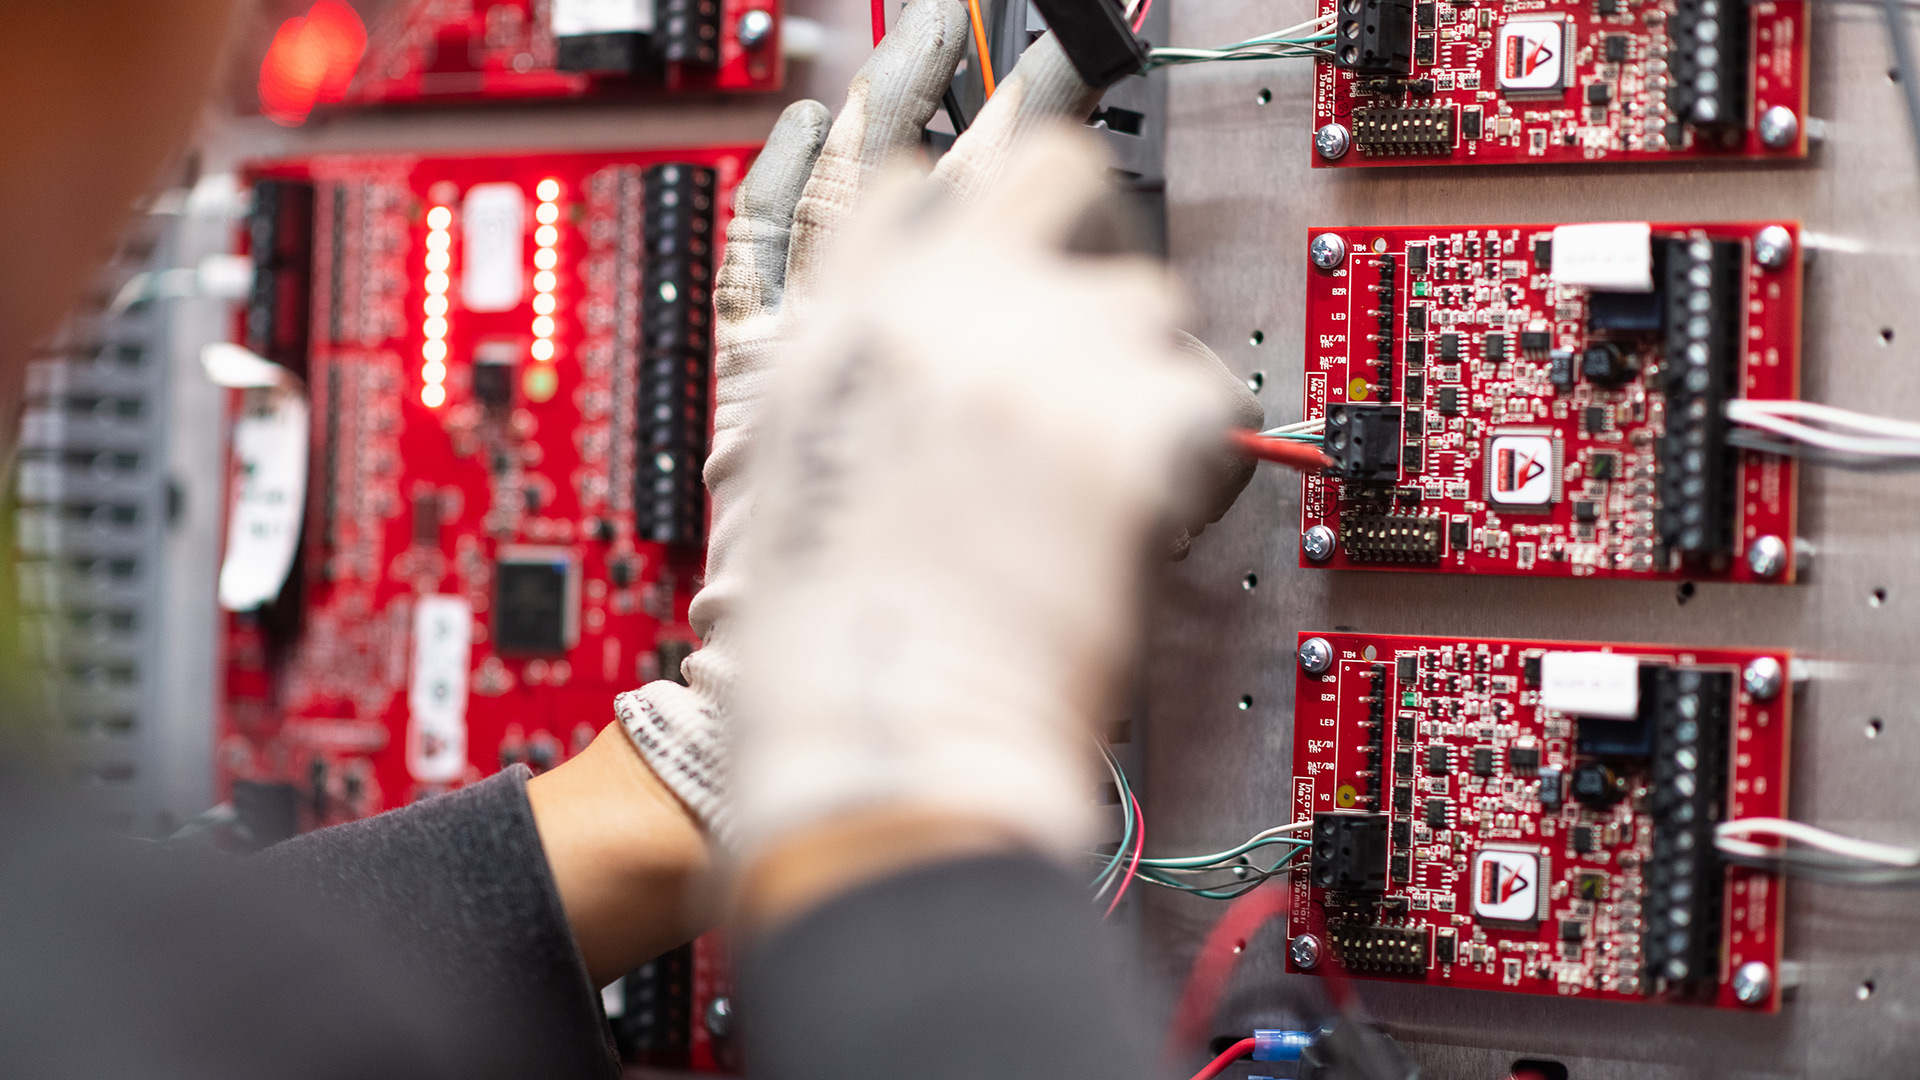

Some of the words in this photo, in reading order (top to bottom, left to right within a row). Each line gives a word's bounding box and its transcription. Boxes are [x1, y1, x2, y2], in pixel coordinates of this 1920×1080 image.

[1419, 72, 1429, 81] J2
[1317, 73, 1328, 117] Damage
[1353, 244, 1367, 252] TB4
[1332, 269, 1347, 277] GND
[1332, 287, 1347, 295] BZR
[1331, 312, 1346, 321] LED
[1309, 377, 1319, 400] May
[1407, 479, 1418, 487] J2
[1342, 651, 1357, 659] TB4
[1321, 675, 1337, 683] GND
[1320, 718, 1335, 726] LED
[1297, 783, 1306, 805] May
[1395, 889, 1404, 897] J2
[1292, 880, 1302, 925] Damage
